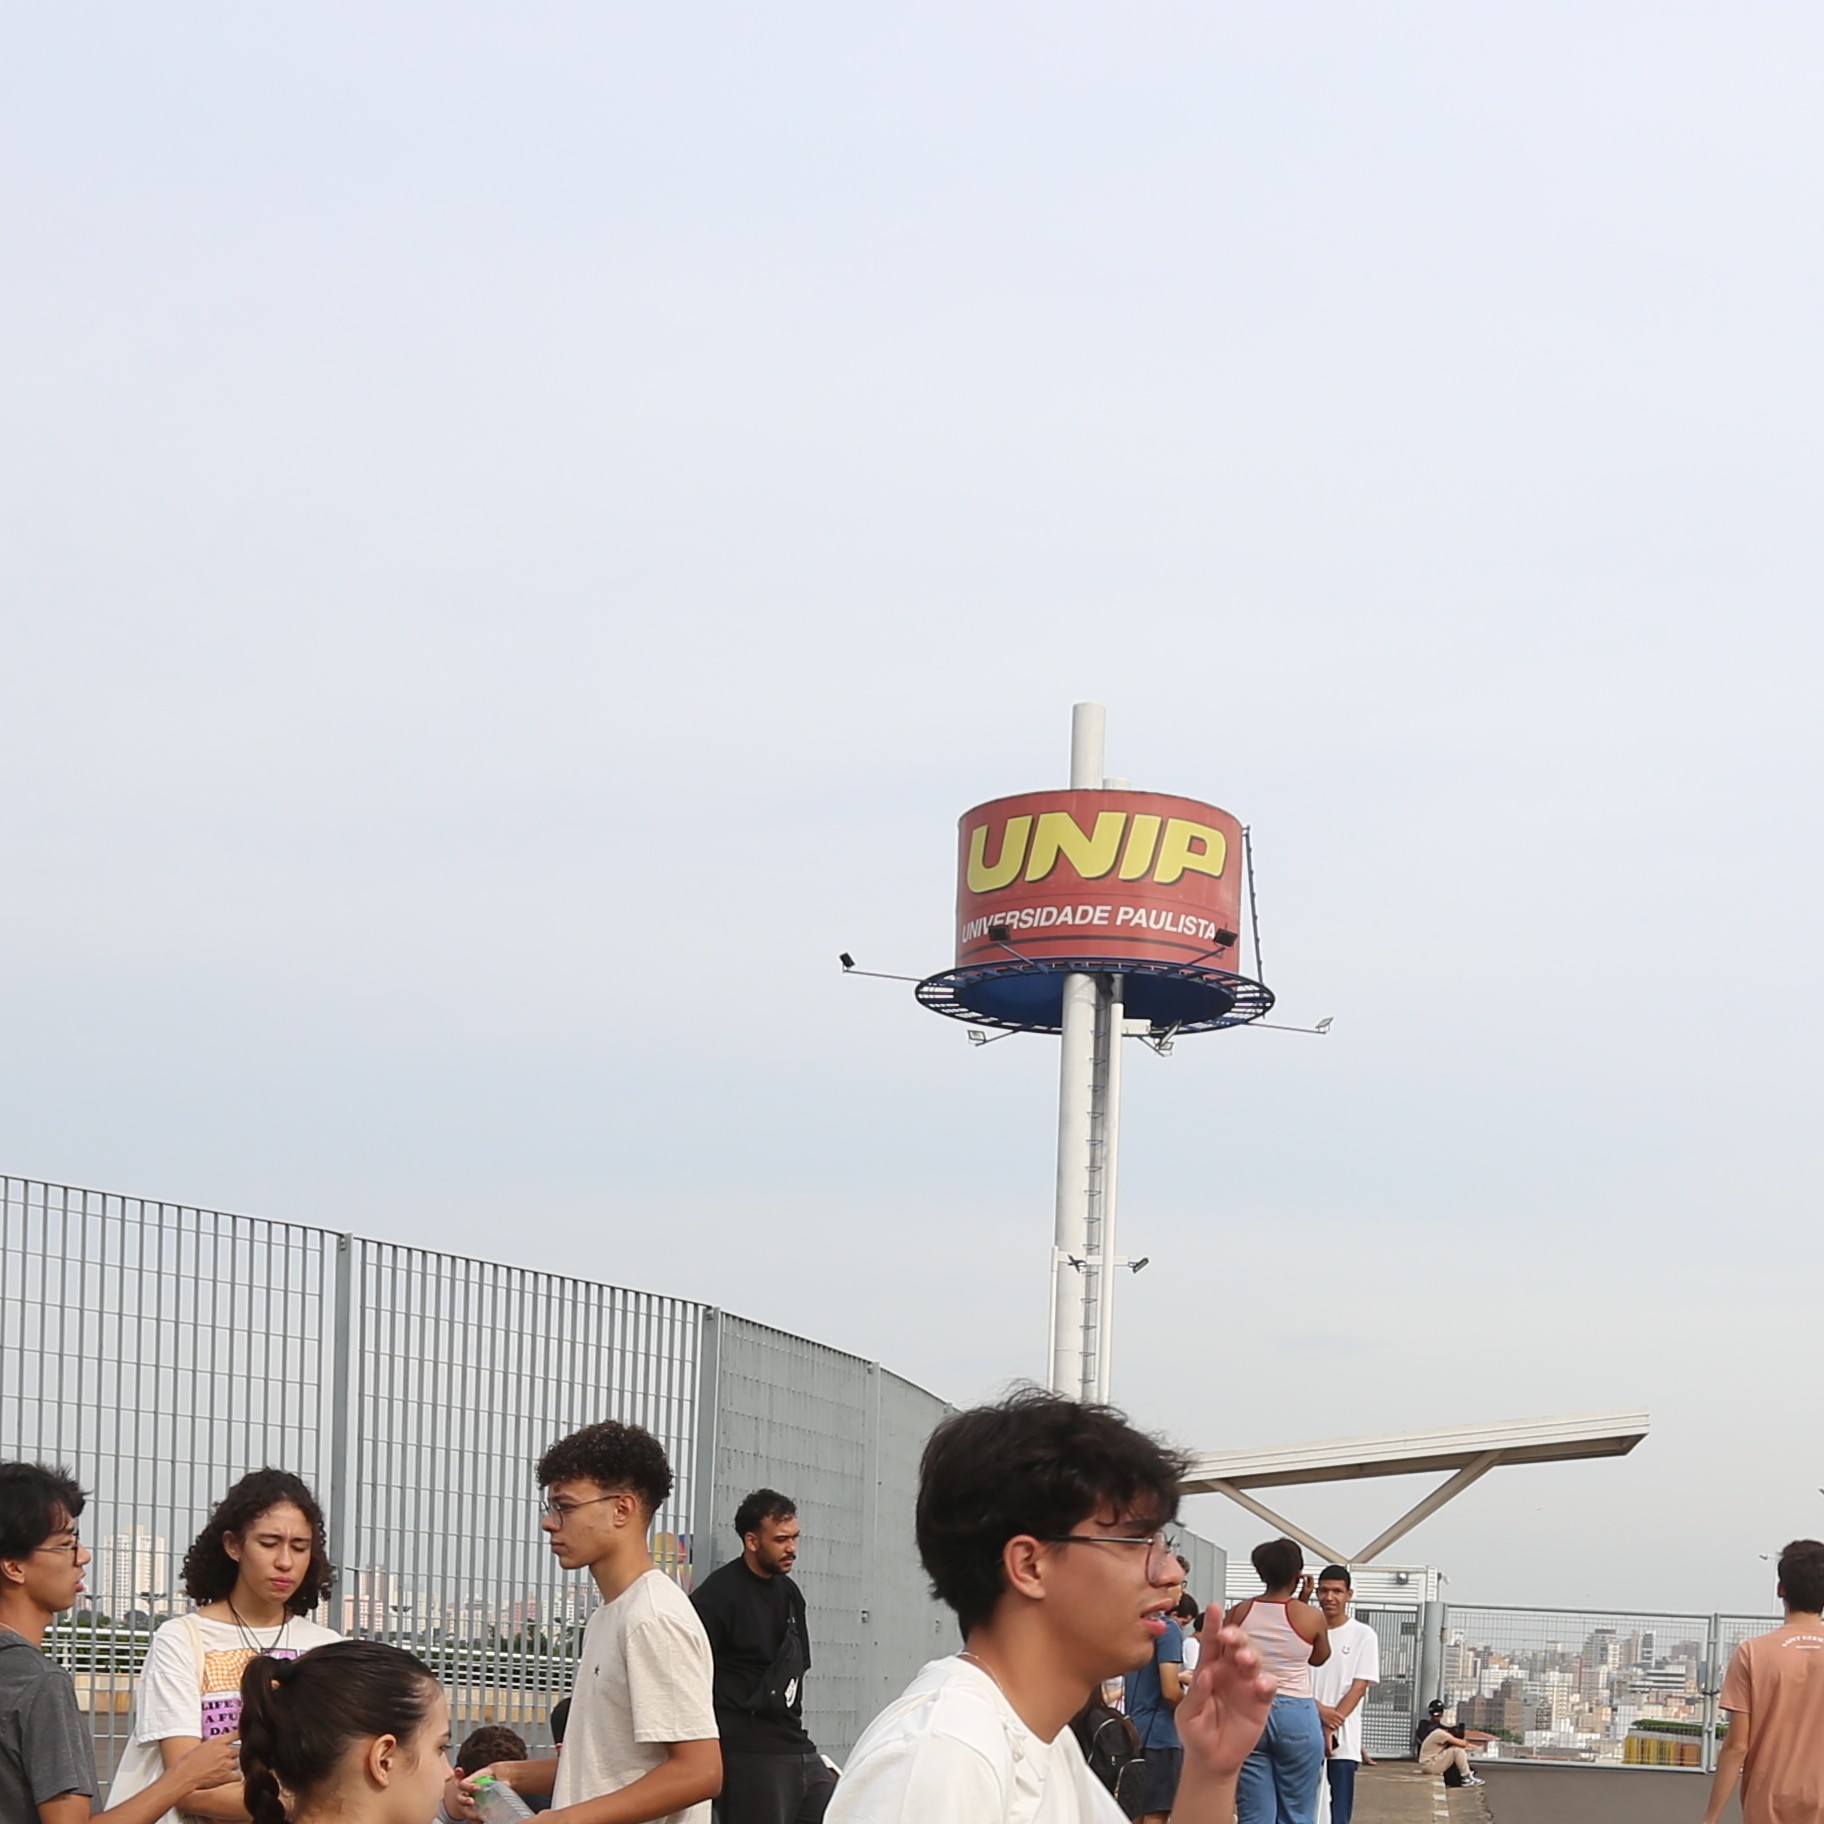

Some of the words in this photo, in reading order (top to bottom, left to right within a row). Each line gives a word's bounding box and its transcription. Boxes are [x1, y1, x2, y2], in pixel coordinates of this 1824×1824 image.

[966, 810, 1228, 893] UNIP
[962, 905, 1113, 944] UNIVERSIDADE
[1116, 907, 1217, 940] PAULISTA
[201, 1700, 234, 1711] LIFE
[205, 1714, 215, 1724] A
